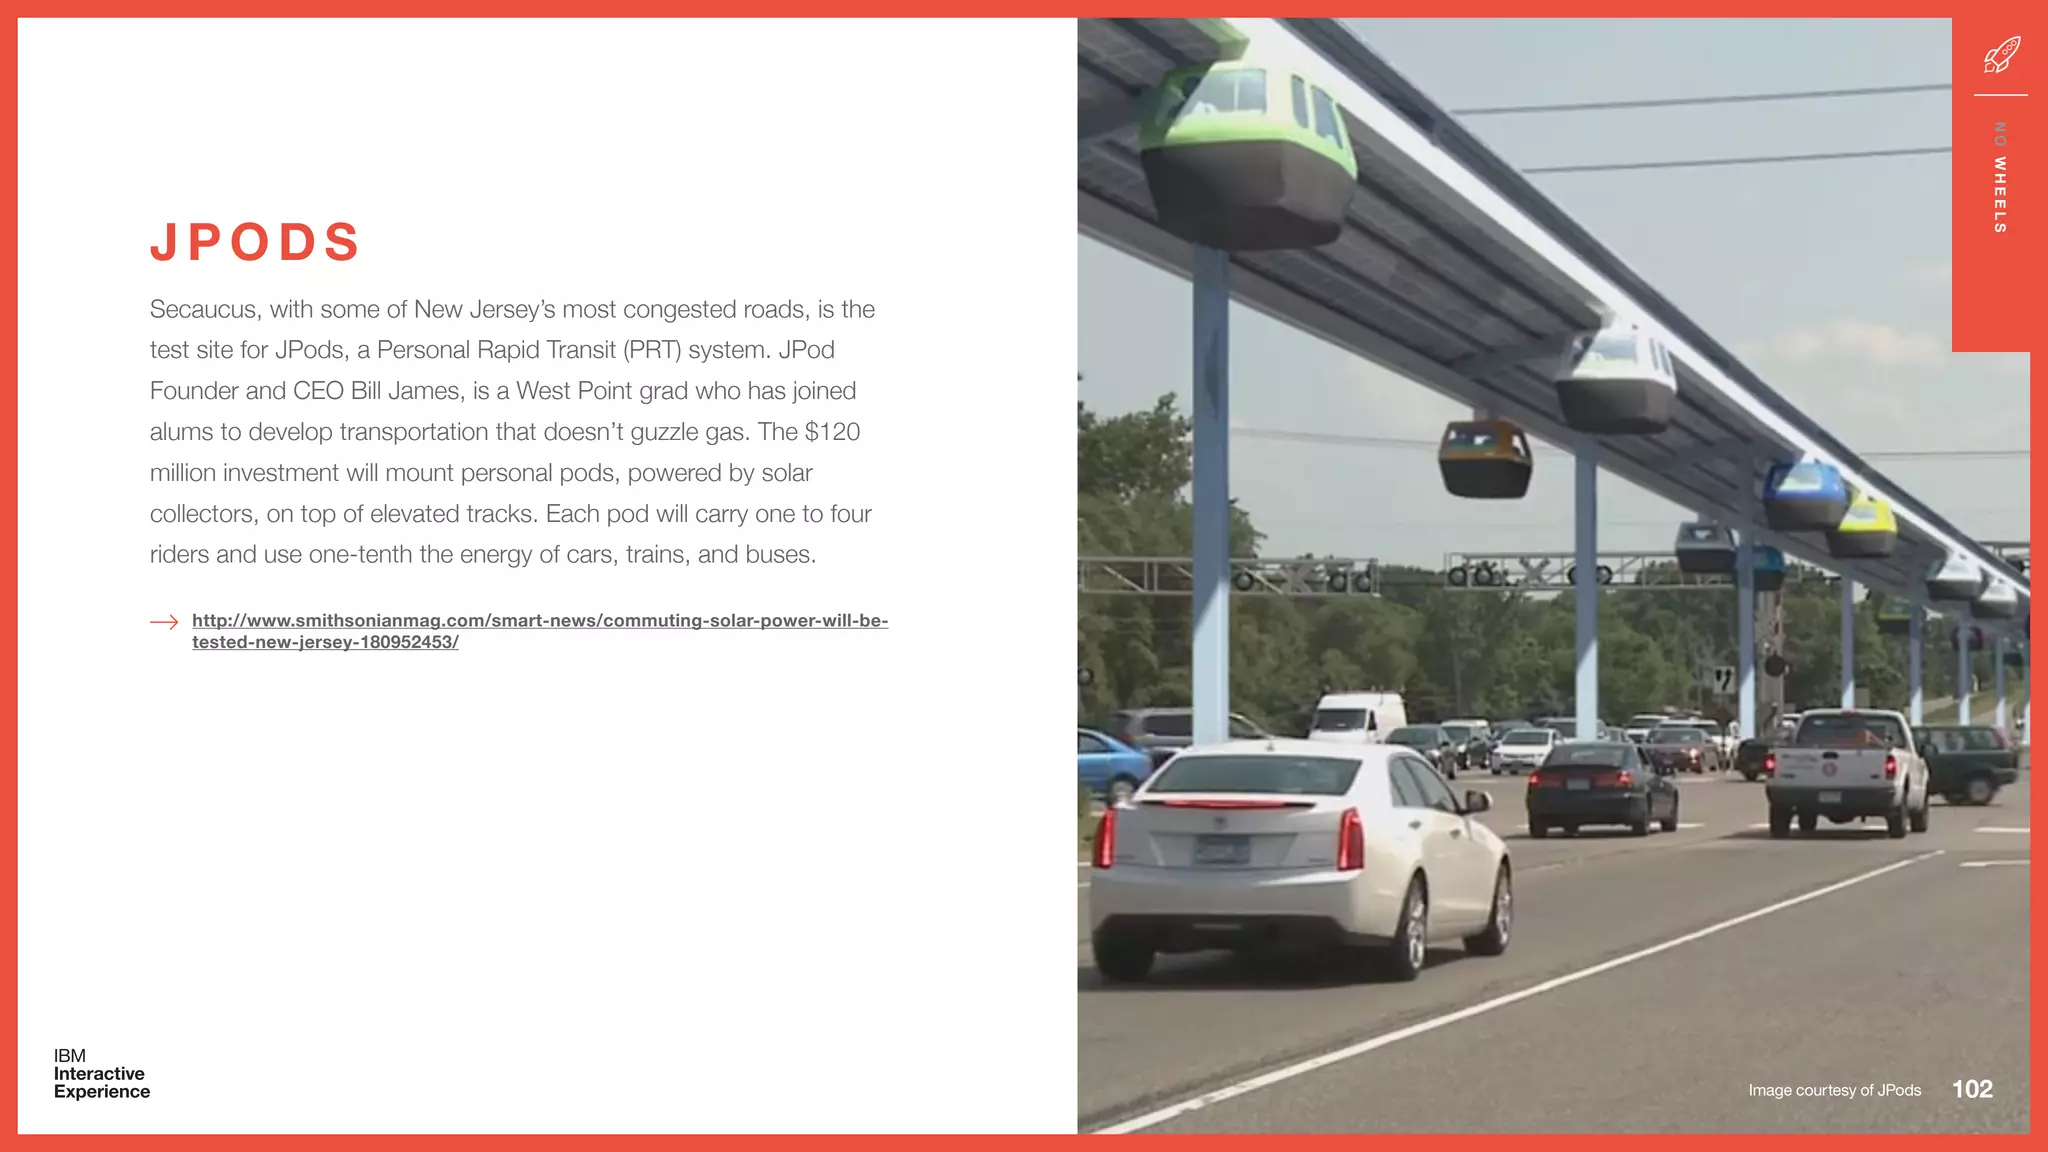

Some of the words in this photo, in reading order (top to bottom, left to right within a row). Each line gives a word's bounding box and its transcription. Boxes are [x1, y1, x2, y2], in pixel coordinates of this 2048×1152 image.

[150, 222, 357, 261] JPODS
[151, 299, 261, 321] Secaucus,
[270, 299, 312, 318] with
[321, 304, 379, 318] some
[387, 300, 408, 318] of
[416, 299, 463, 318] New
[470, 299, 555, 322] Jersey’s
[564, 301, 616, 318] most
[624, 299, 736, 323] congested
[745, 300, 809, 321] roads,
[819, 299, 834, 318] is
[842, 299, 875, 318] the
[150, 341, 189, 359] test
[197, 340, 233, 359] site
[240, 340, 268, 359] for
[276, 340, 348, 361] JPods,
[358, 345, 370, 359] a
[379, 340, 469, 359] Personal
[479, 340, 539, 363] Rapid
[546, 340, 616, 359] Transit
[624, 340, 681, 363] (PRT)
[689, 341, 770, 363] system.
[779, 340, 834, 359] JPod
[152, 381, 239, 400] Founder
[246, 381, 285, 400] and
[294, 380, 343, 400] CEO
[353, 381, 380, 399] Bill
[389, 381, 464, 402] James,
[474, 381, 489, 400] is
[497, 386, 510, 400] a
[516, 381, 570, 400] West
[579, 381, 632, 400] Point
[640, 381, 687, 404] grad
[696, 381, 740, 400] who
[749, 381, 786, 400] has
[792, 381, 855, 404] joined
[151, 422, 213, 441] alums
[221, 423, 241, 441] to
[249, 422, 332, 445] develop
[340, 422, 487, 445] transportation
[496, 422, 536, 441] that
[544, 422, 623, 441] doesn’t
[631, 422, 698, 445] guzzle
[706, 427, 749, 445] gas.
[758, 422, 798, 441] The
[806, 420, 860, 442] $120
[151, 463, 215, 482] million
[224, 463, 339, 482] investment
[347, 463, 377, 481] will
[387, 464, 454, 482] mount
[462, 463, 551, 486] personal
[561, 463, 619, 486] pods,
[629, 463, 721, 486] powered
[730, 463, 755, 486] by
[762, 463, 813, 482] solar
[151, 504, 258, 525] collectors,
[267, 509, 293, 523] on
[301, 505, 335, 527] top
[344, 504, 364, 523] of
[371, 504, 459, 523] elevated
[467, 504, 537, 523] tracks.
[548, 504, 599, 523] Each
[608, 504, 648, 527] pod
[656, 504, 687, 522] will
[696, 509, 748, 527] carry
[756, 509, 795, 523] one
[802, 505, 823, 523] to
[831, 504, 872, 523] four
[151, 544, 209, 563] riders
[217, 544, 256, 563] and
[265, 549, 302, 563] use
[310, 544, 411, 563] one-tenth
[420, 544, 453, 563] the
[461, 549, 532, 568] energy
[540, 545, 560, 563] of
[567, 549, 617, 566] cars,
[626, 544, 689, 566] trains,
[699, 544, 737, 563] and
[747, 544, 815, 563] buses.
[192, 613, 889, 630] http://www.smithsonianmag.com/smart-news/commuting-solar-power-will-be-
[192, 635, 459, 652] tested-new-jersey-180952453/
[55, 1049, 85, 1062] IBM
[55, 1066, 145, 1080] Interactive
[55, 1084, 150, 1101] Experience
